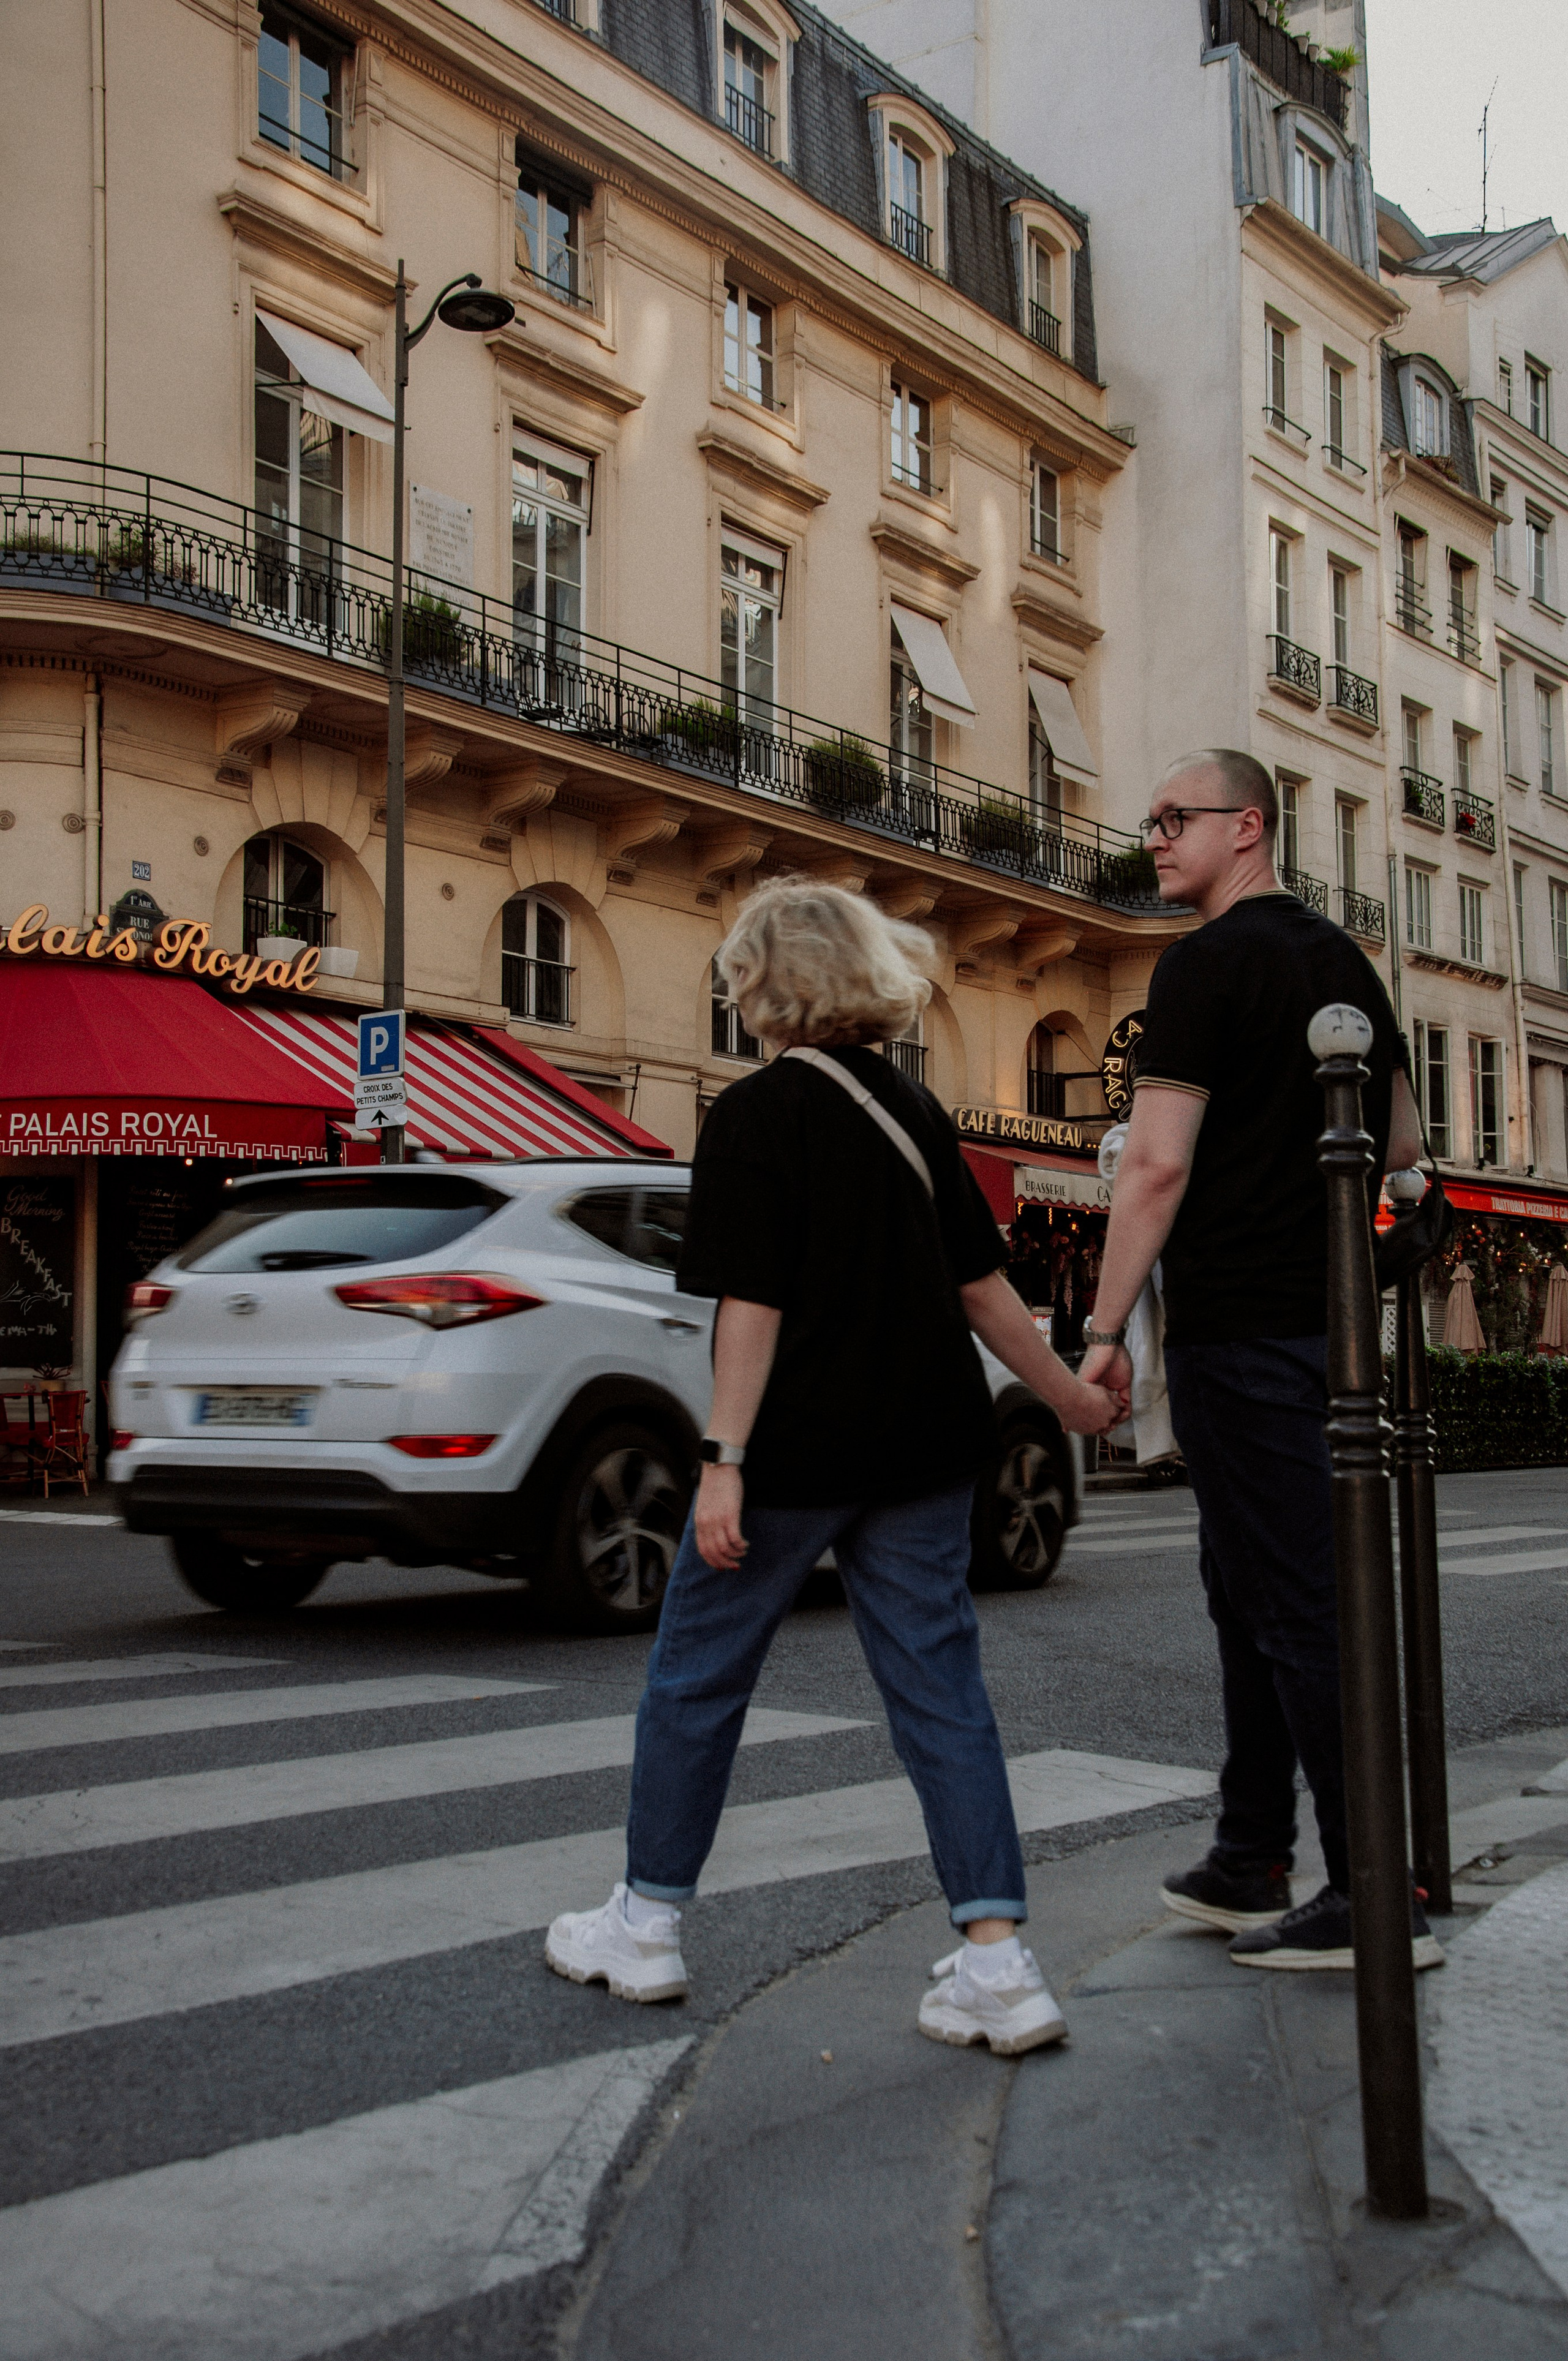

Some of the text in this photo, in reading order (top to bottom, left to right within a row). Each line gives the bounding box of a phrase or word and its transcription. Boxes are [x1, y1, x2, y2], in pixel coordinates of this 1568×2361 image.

[134, 864, 149, 878] 202
[130, 916, 149, 928] RUE
[0, 904, 322, 993] lais Royal
[370, 1026, 389, 1065] P
[356, 1092, 403, 1105] PETITS CHAMPS
[363, 1083, 393, 1093] CROIX DES
[9, 1112, 217, 1138] PALAIS ROYAL
[957, 1108, 1082, 1148] CAFE RAGUENEAU
[4, 1184, 48, 1212] Good
[1025, 1180, 1111, 1202] BRASSERIE CA
[9, 1200, 66, 1222] Morning
[1491, 1196, 1526, 1214] TRATTORIA
[1526, 1202, 1553, 1218] PIZZERIA
[1554, 1205, 1559, 1218] E
[1, 1217, 73, 1308] BREAKFAST
